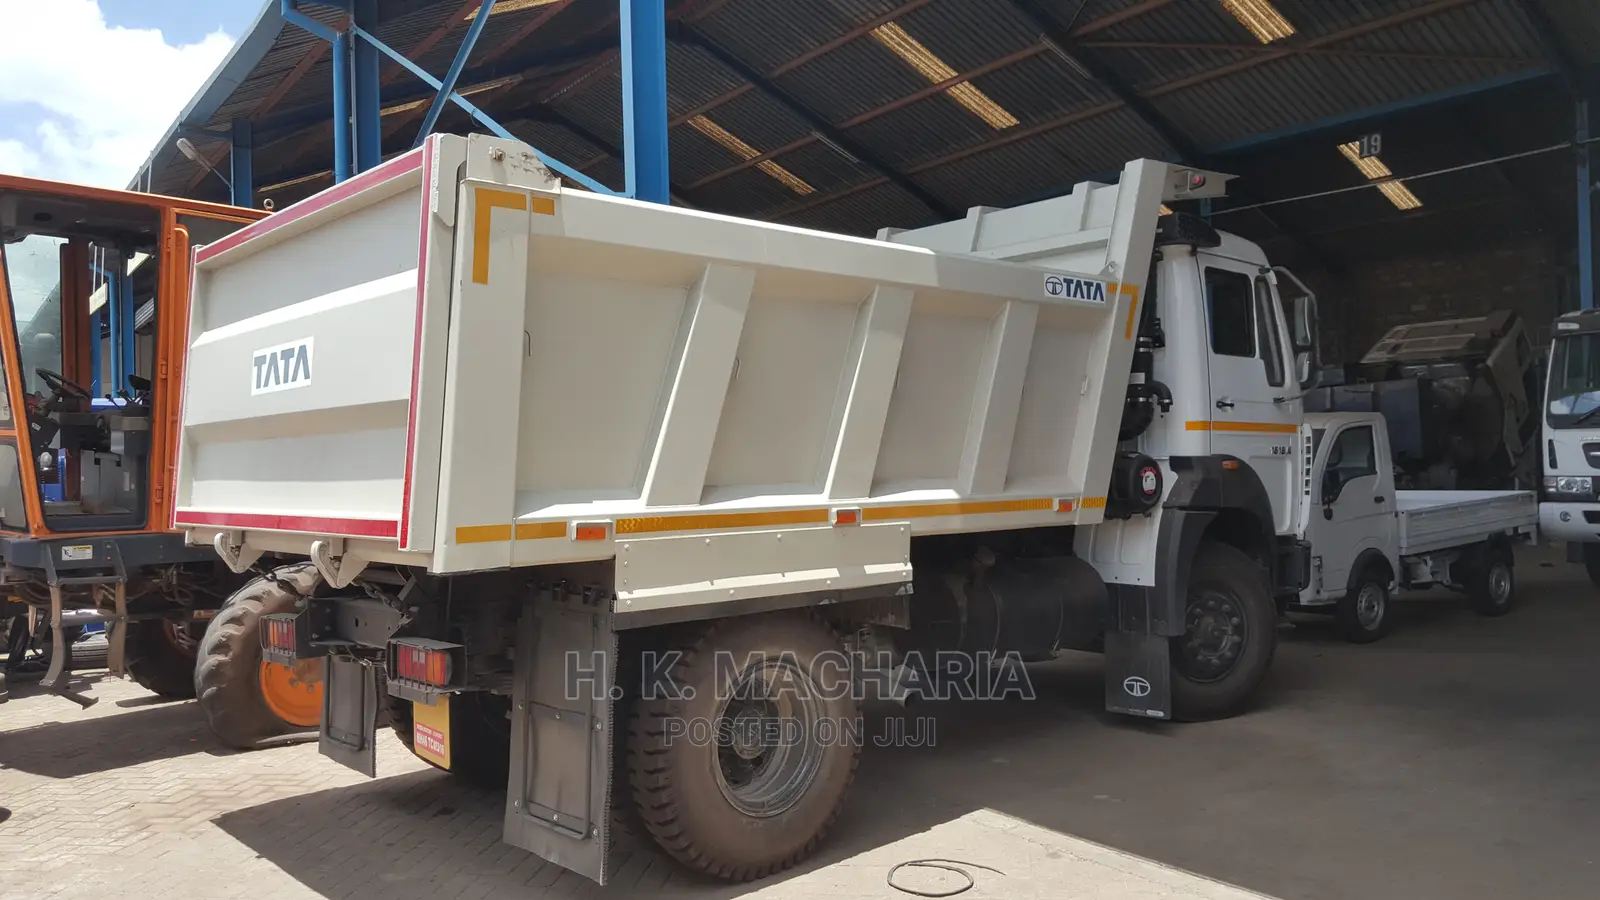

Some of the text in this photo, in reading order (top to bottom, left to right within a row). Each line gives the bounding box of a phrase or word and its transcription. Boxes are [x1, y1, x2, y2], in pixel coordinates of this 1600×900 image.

[1360, 134, 1381, 157] 19
[1063, 277, 1105, 302] TATA
[253, 344, 311, 390] TATA
